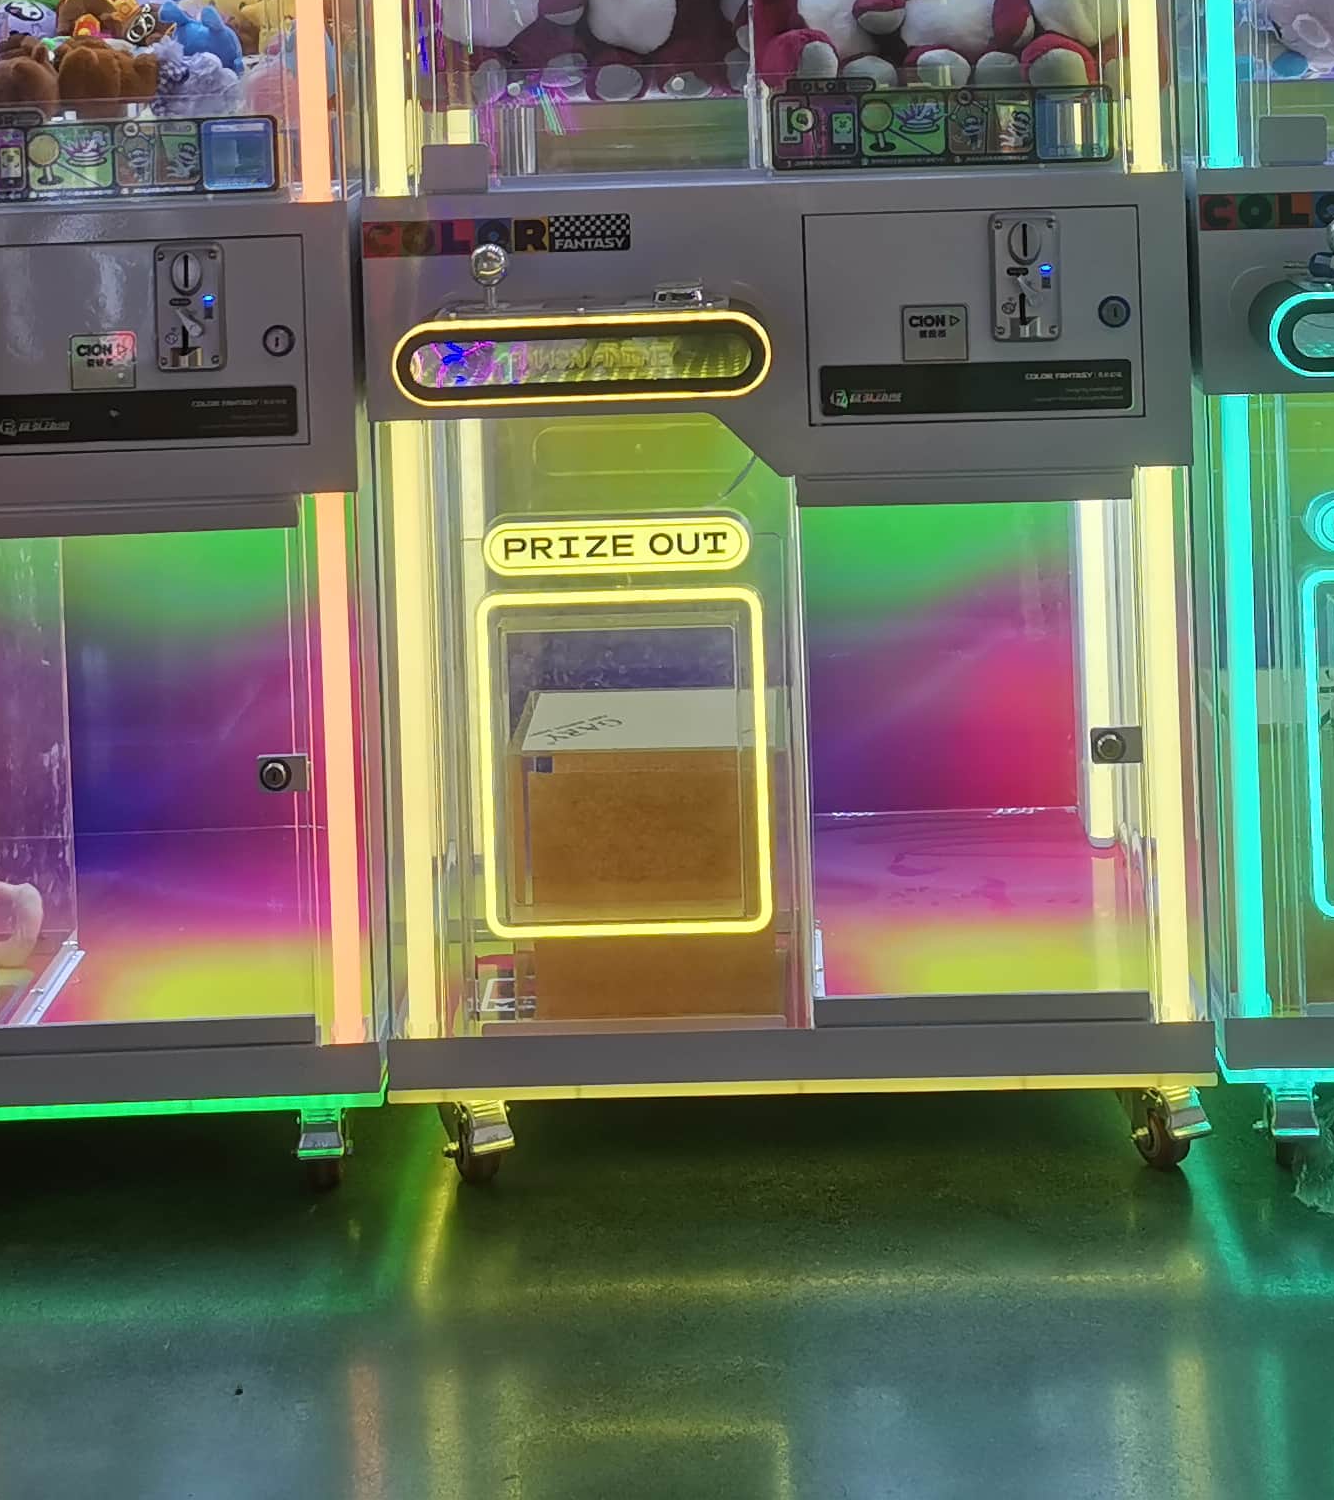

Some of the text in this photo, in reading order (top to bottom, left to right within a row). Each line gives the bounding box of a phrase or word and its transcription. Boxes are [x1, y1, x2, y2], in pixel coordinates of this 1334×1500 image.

[363, 217, 626, 257] COLOR FANTASY
[908, 314, 946, 328] CION
[76, 343, 113, 357] CION
[503, 530, 729, 561] PRIZE OUT
